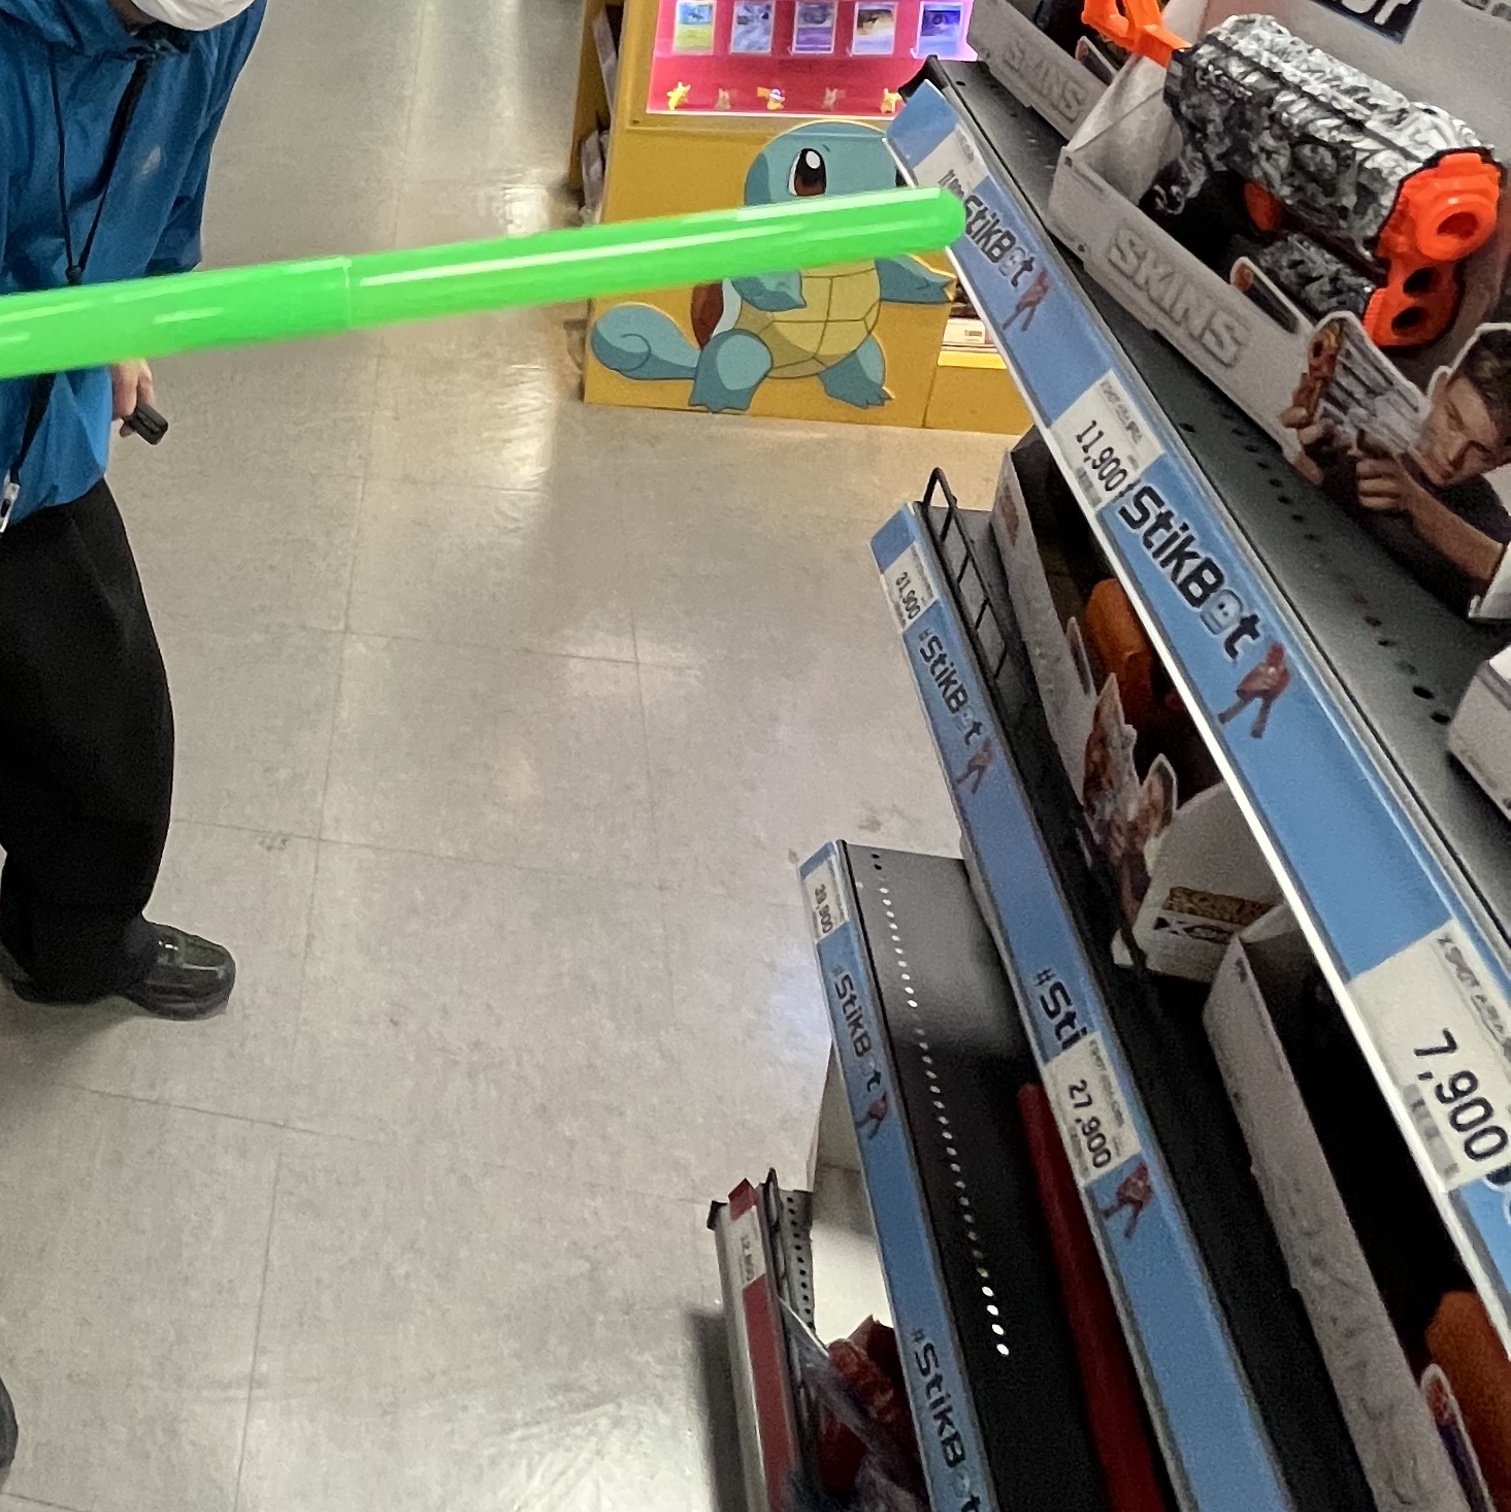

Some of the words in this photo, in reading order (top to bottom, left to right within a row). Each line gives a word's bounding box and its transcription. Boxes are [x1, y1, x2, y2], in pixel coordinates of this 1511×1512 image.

[1109, 226, 1253, 368] SKINS
[1074, 418, 1126, 494] 11,900
[1067, 1079, 1112, 1169] 27,900
[1414, 1028, 1510, 1162] 7,900
